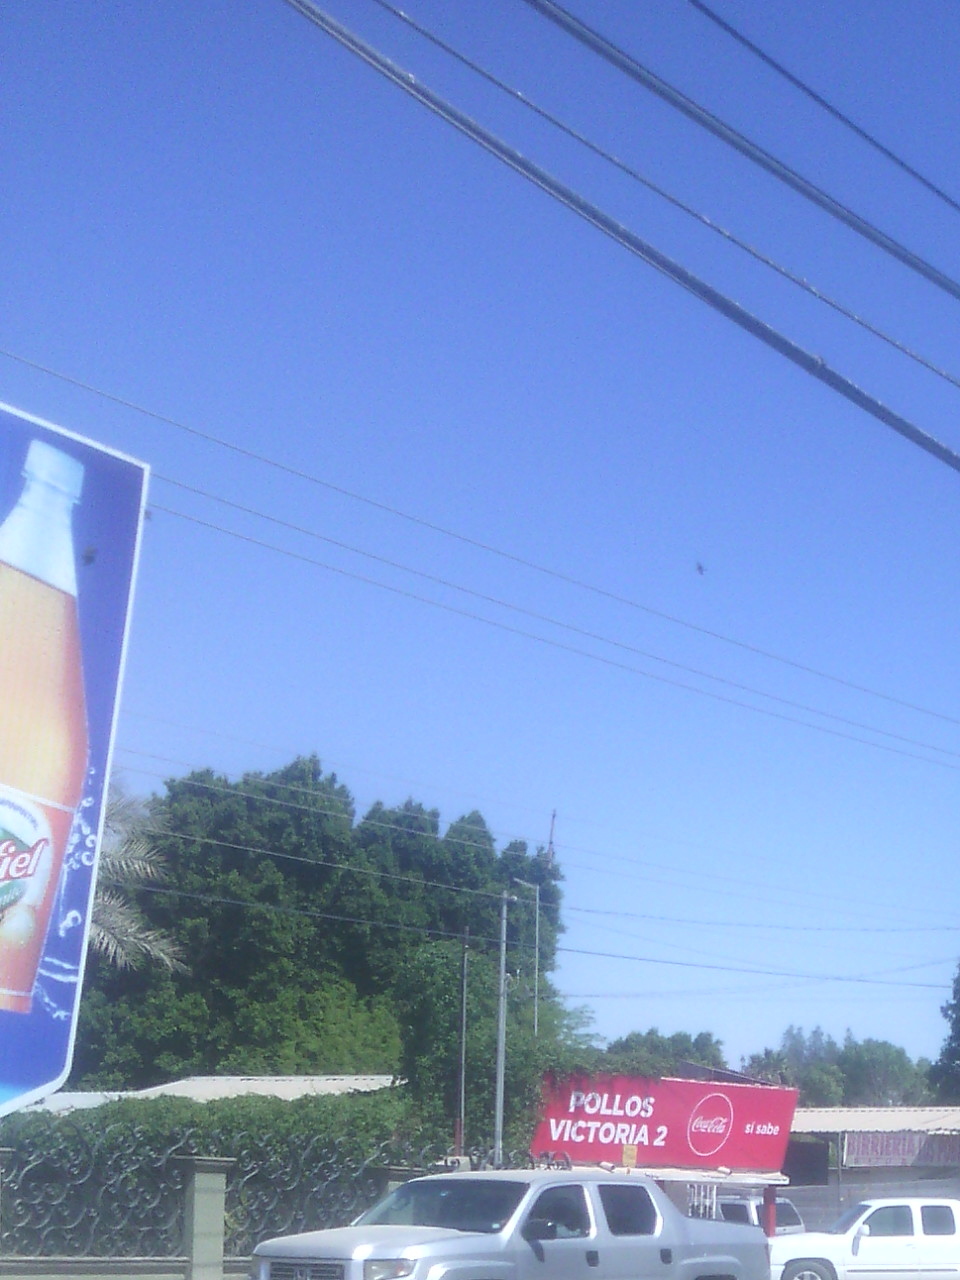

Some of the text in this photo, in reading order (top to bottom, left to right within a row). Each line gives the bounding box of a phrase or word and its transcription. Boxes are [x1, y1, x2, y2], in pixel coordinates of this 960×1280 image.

[568, 1091, 655, 1118] POLLOS
[549, 1118, 669, 1146] VICTORIA 2
[756, 1122, 780, 1136] sabe
